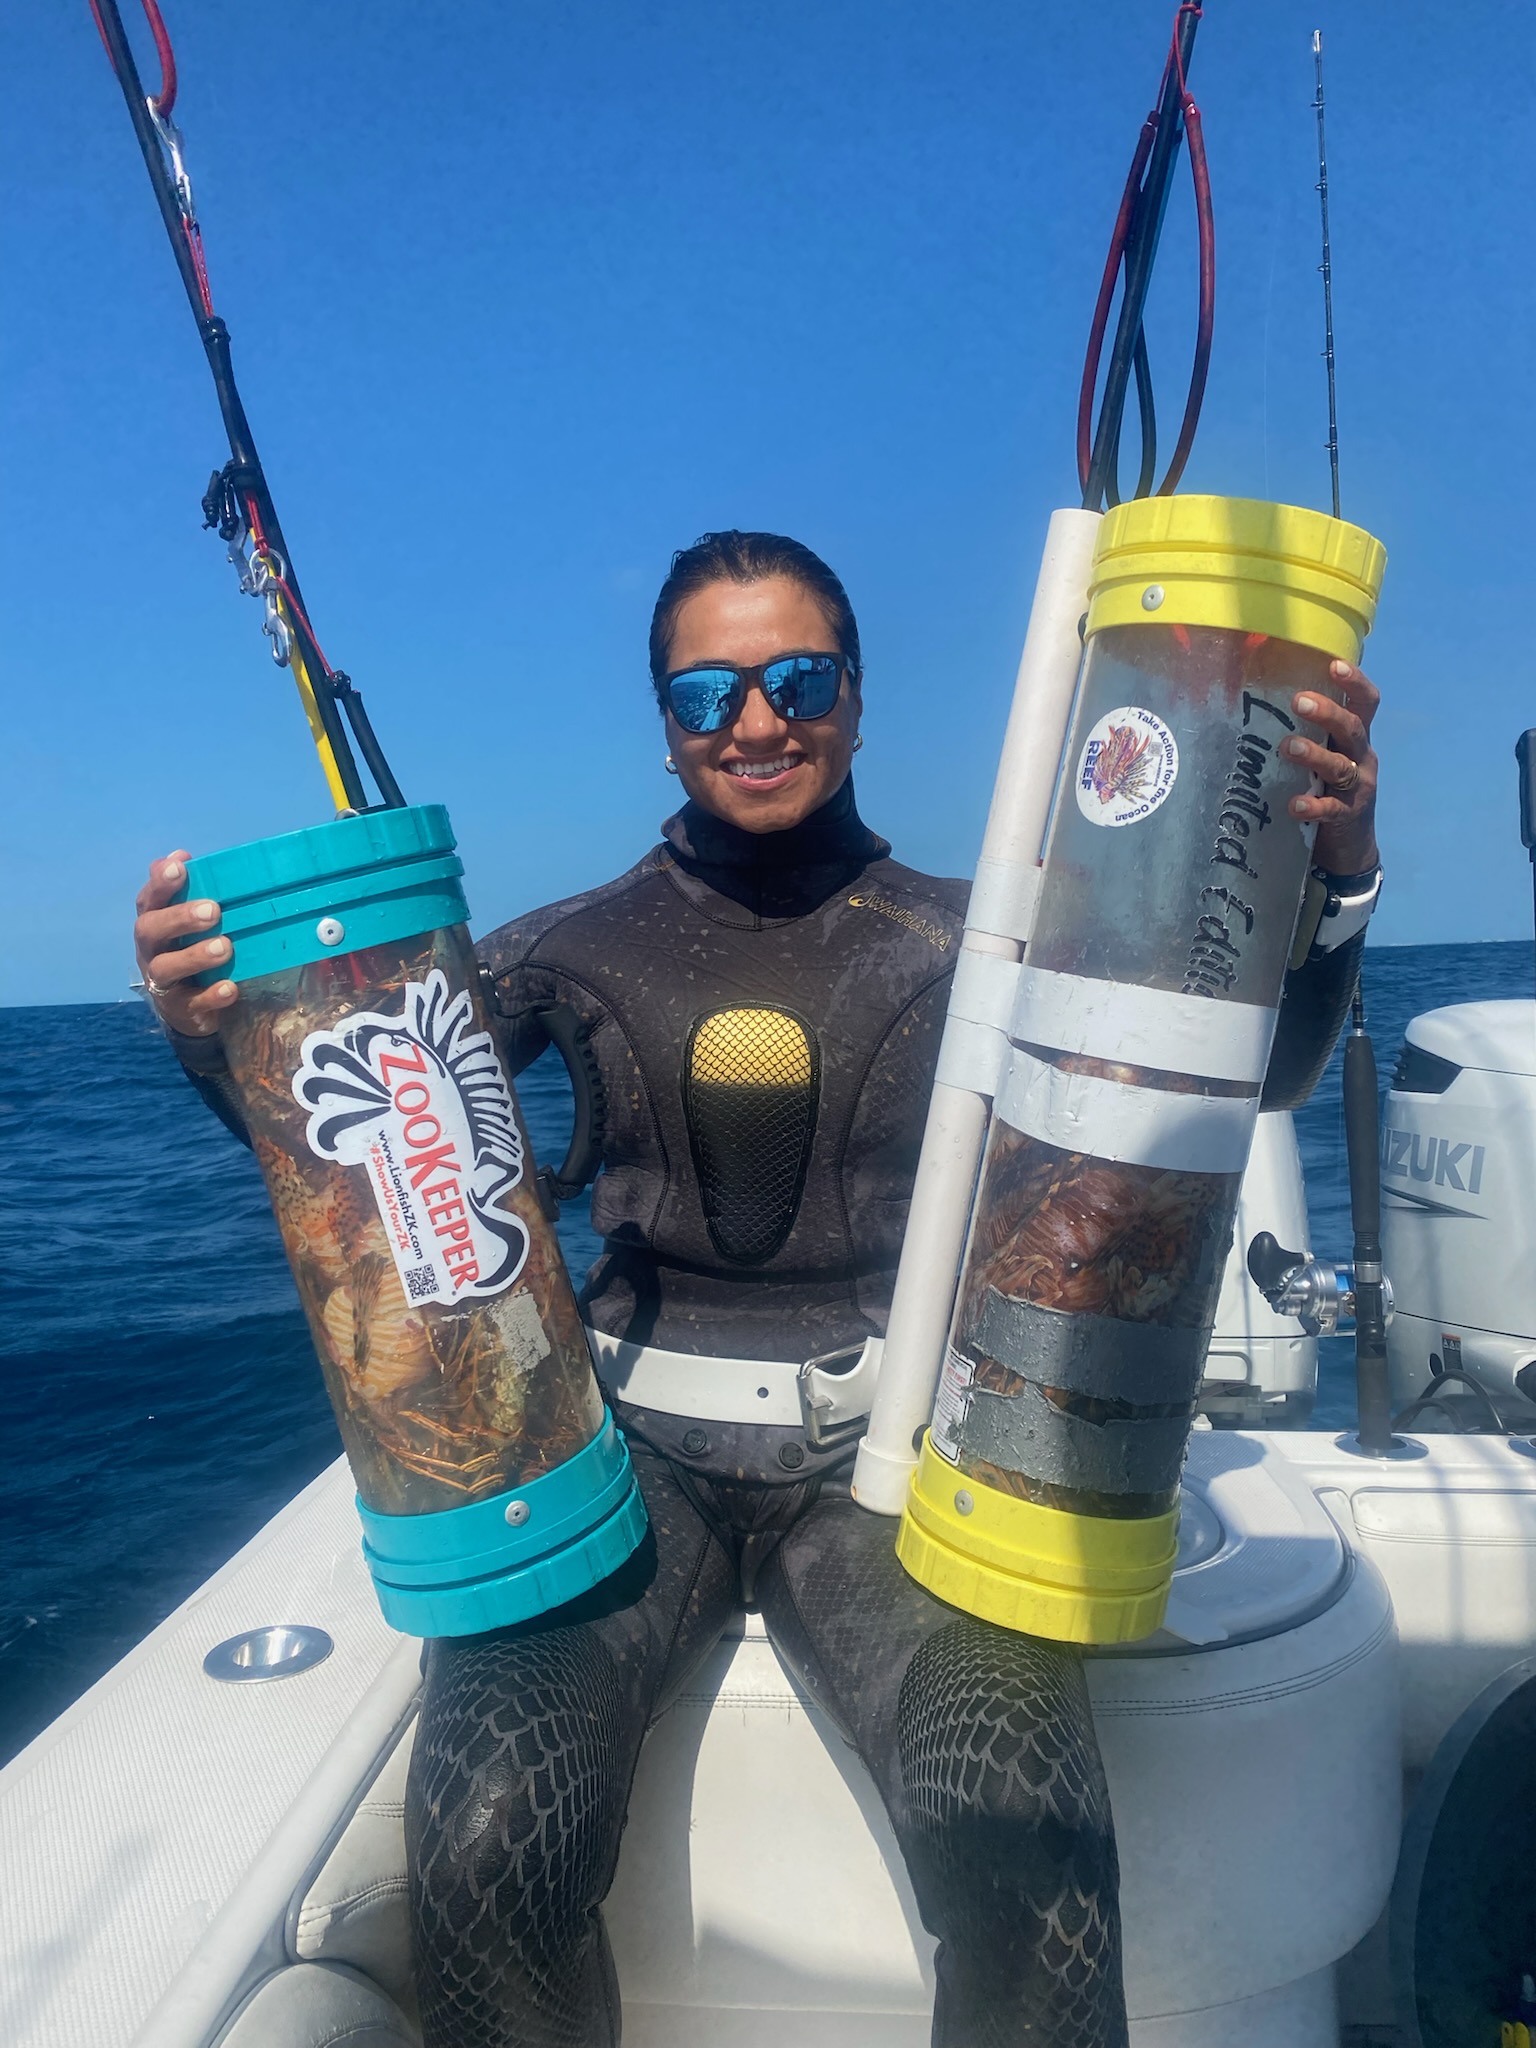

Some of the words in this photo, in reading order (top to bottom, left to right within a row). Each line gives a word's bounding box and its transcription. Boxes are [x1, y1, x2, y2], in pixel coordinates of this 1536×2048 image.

[1137, 711, 1160, 731] Take
[1081, 740, 1102, 791] REEF
[1158, 731, 1175, 766] Action
[1163, 769, 1175, 785] for
[1208, 690, 1296, 879] Limited
[1115, 804, 1150, 822] Ocean
[868, 896, 952, 952] WAIHANA
[369, 1145, 412, 1251] #ShowUsYourZK
[377, 1129, 424, 1261] www.LionfishZK.com
